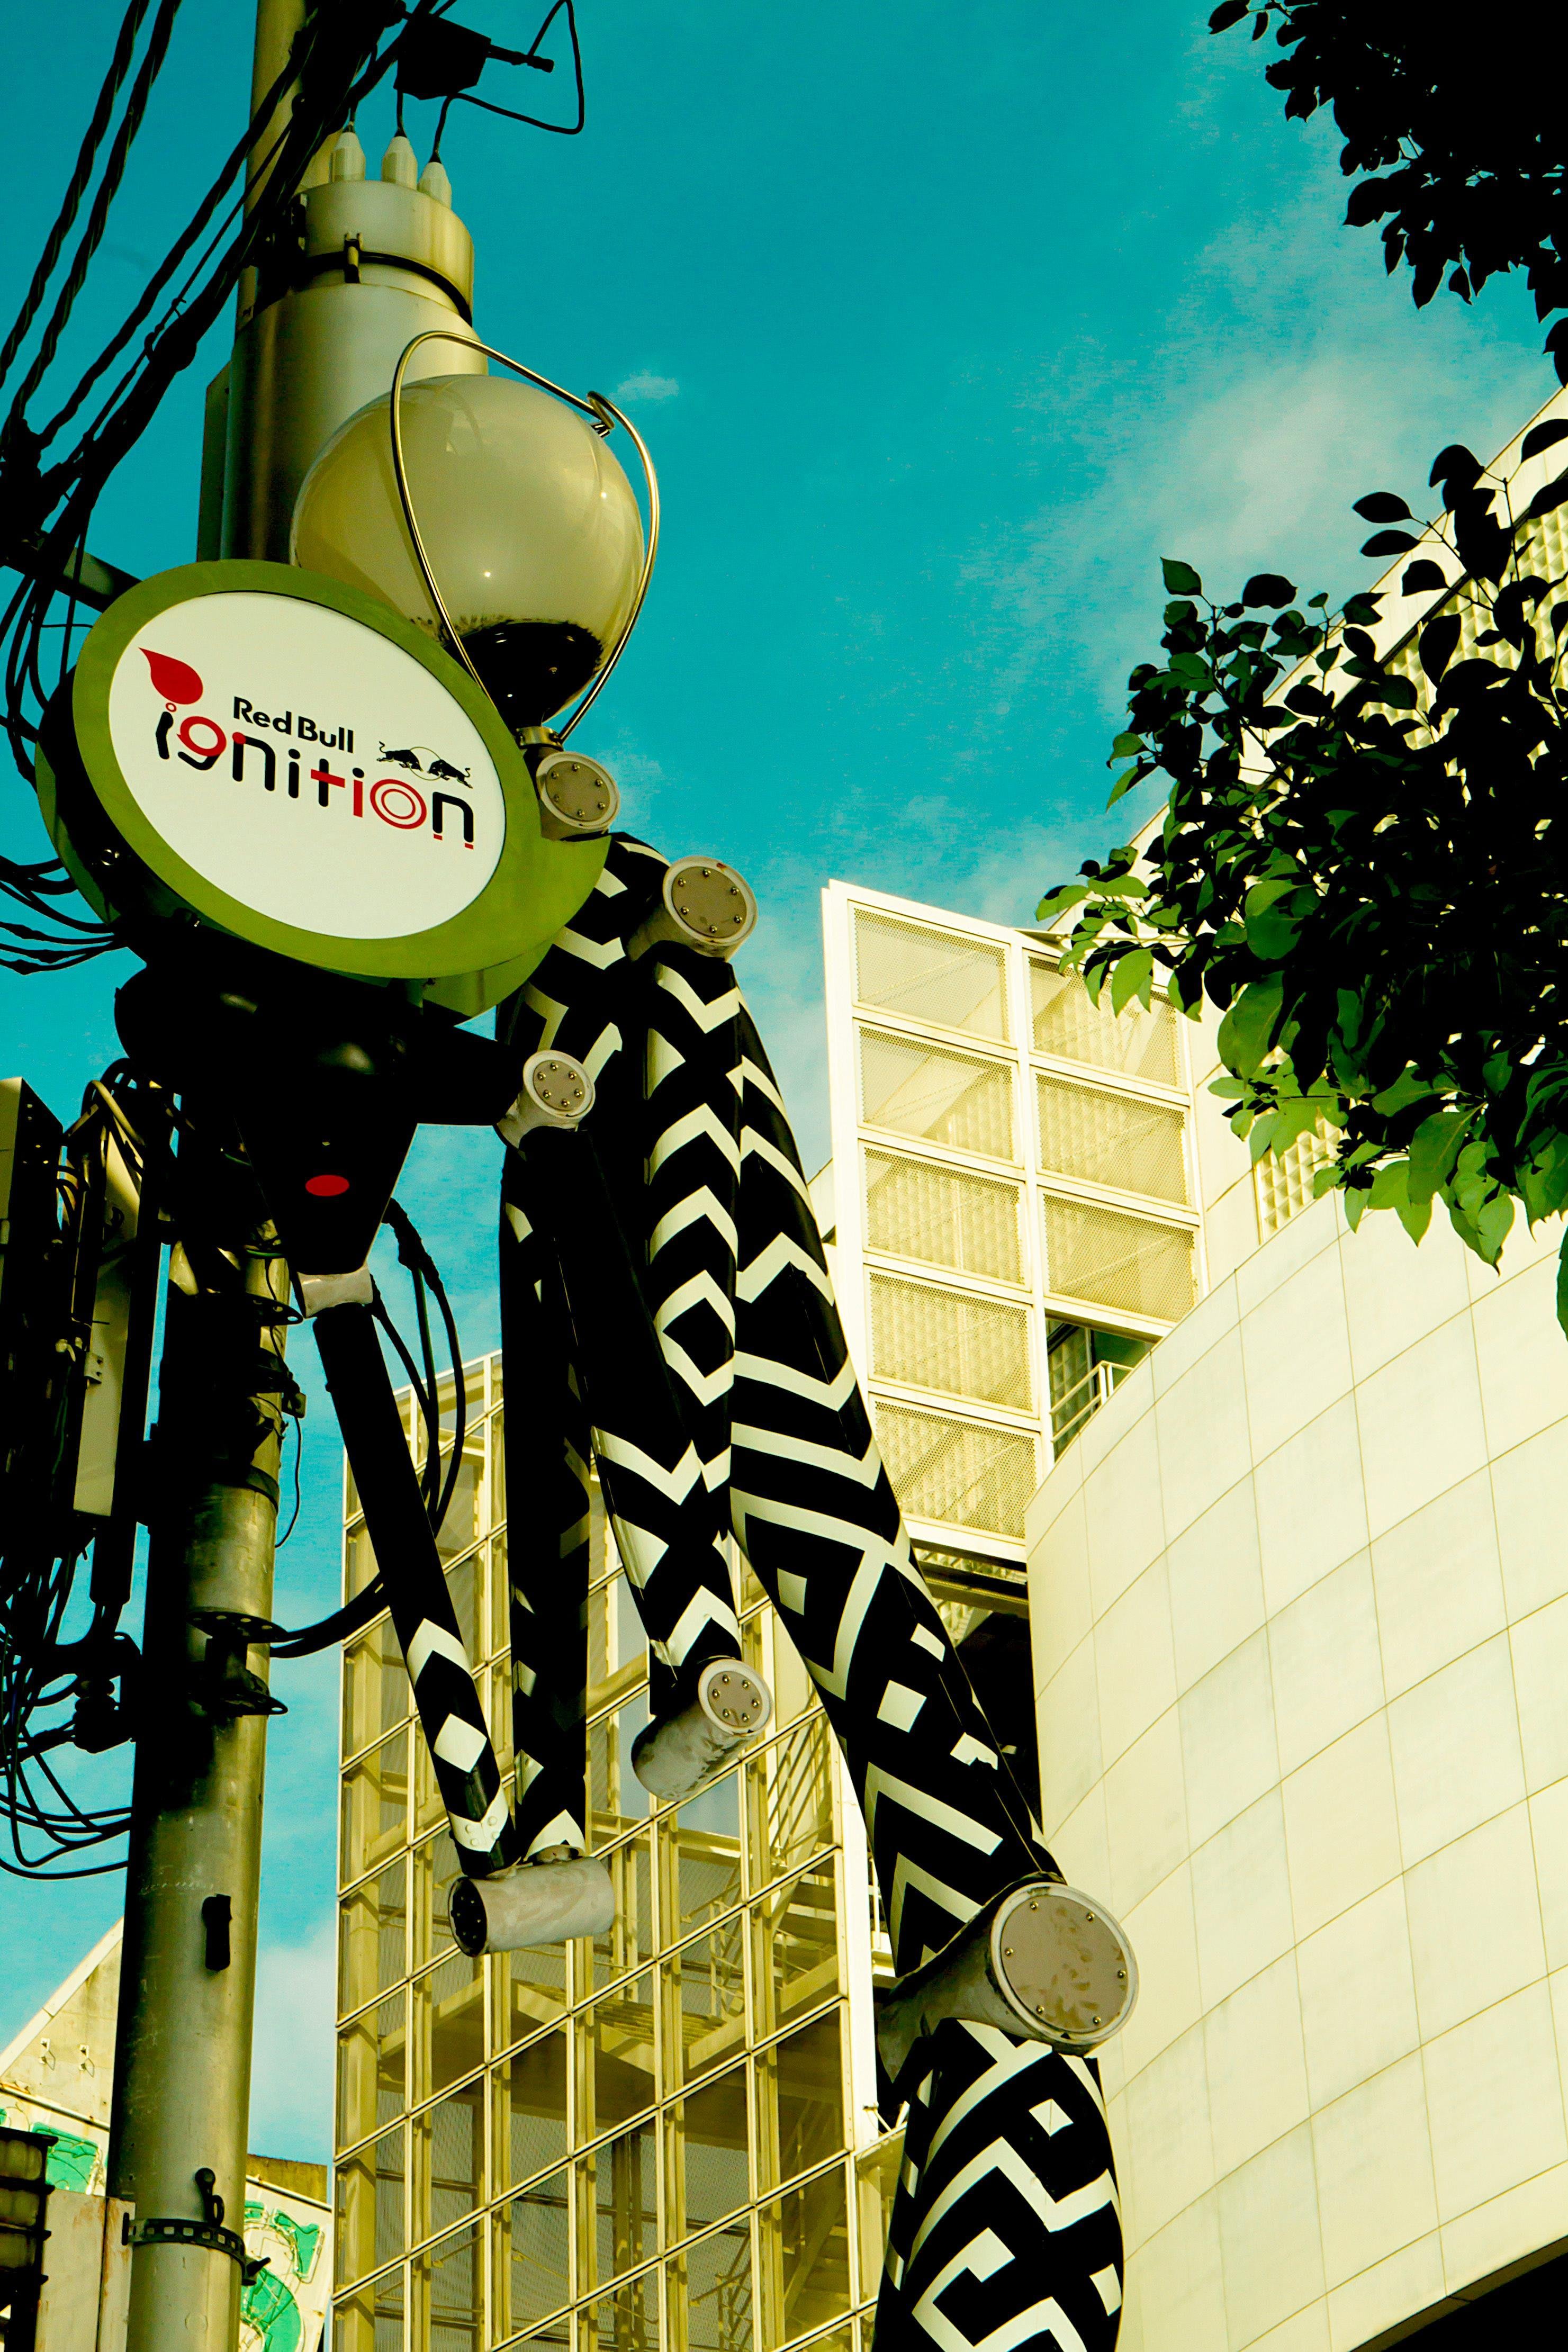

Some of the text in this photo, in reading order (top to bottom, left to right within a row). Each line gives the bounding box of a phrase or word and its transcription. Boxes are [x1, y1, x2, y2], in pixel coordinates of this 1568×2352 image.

[155, 702, 474, 850] ignition
[233, 696, 354, 754] Red Bull
